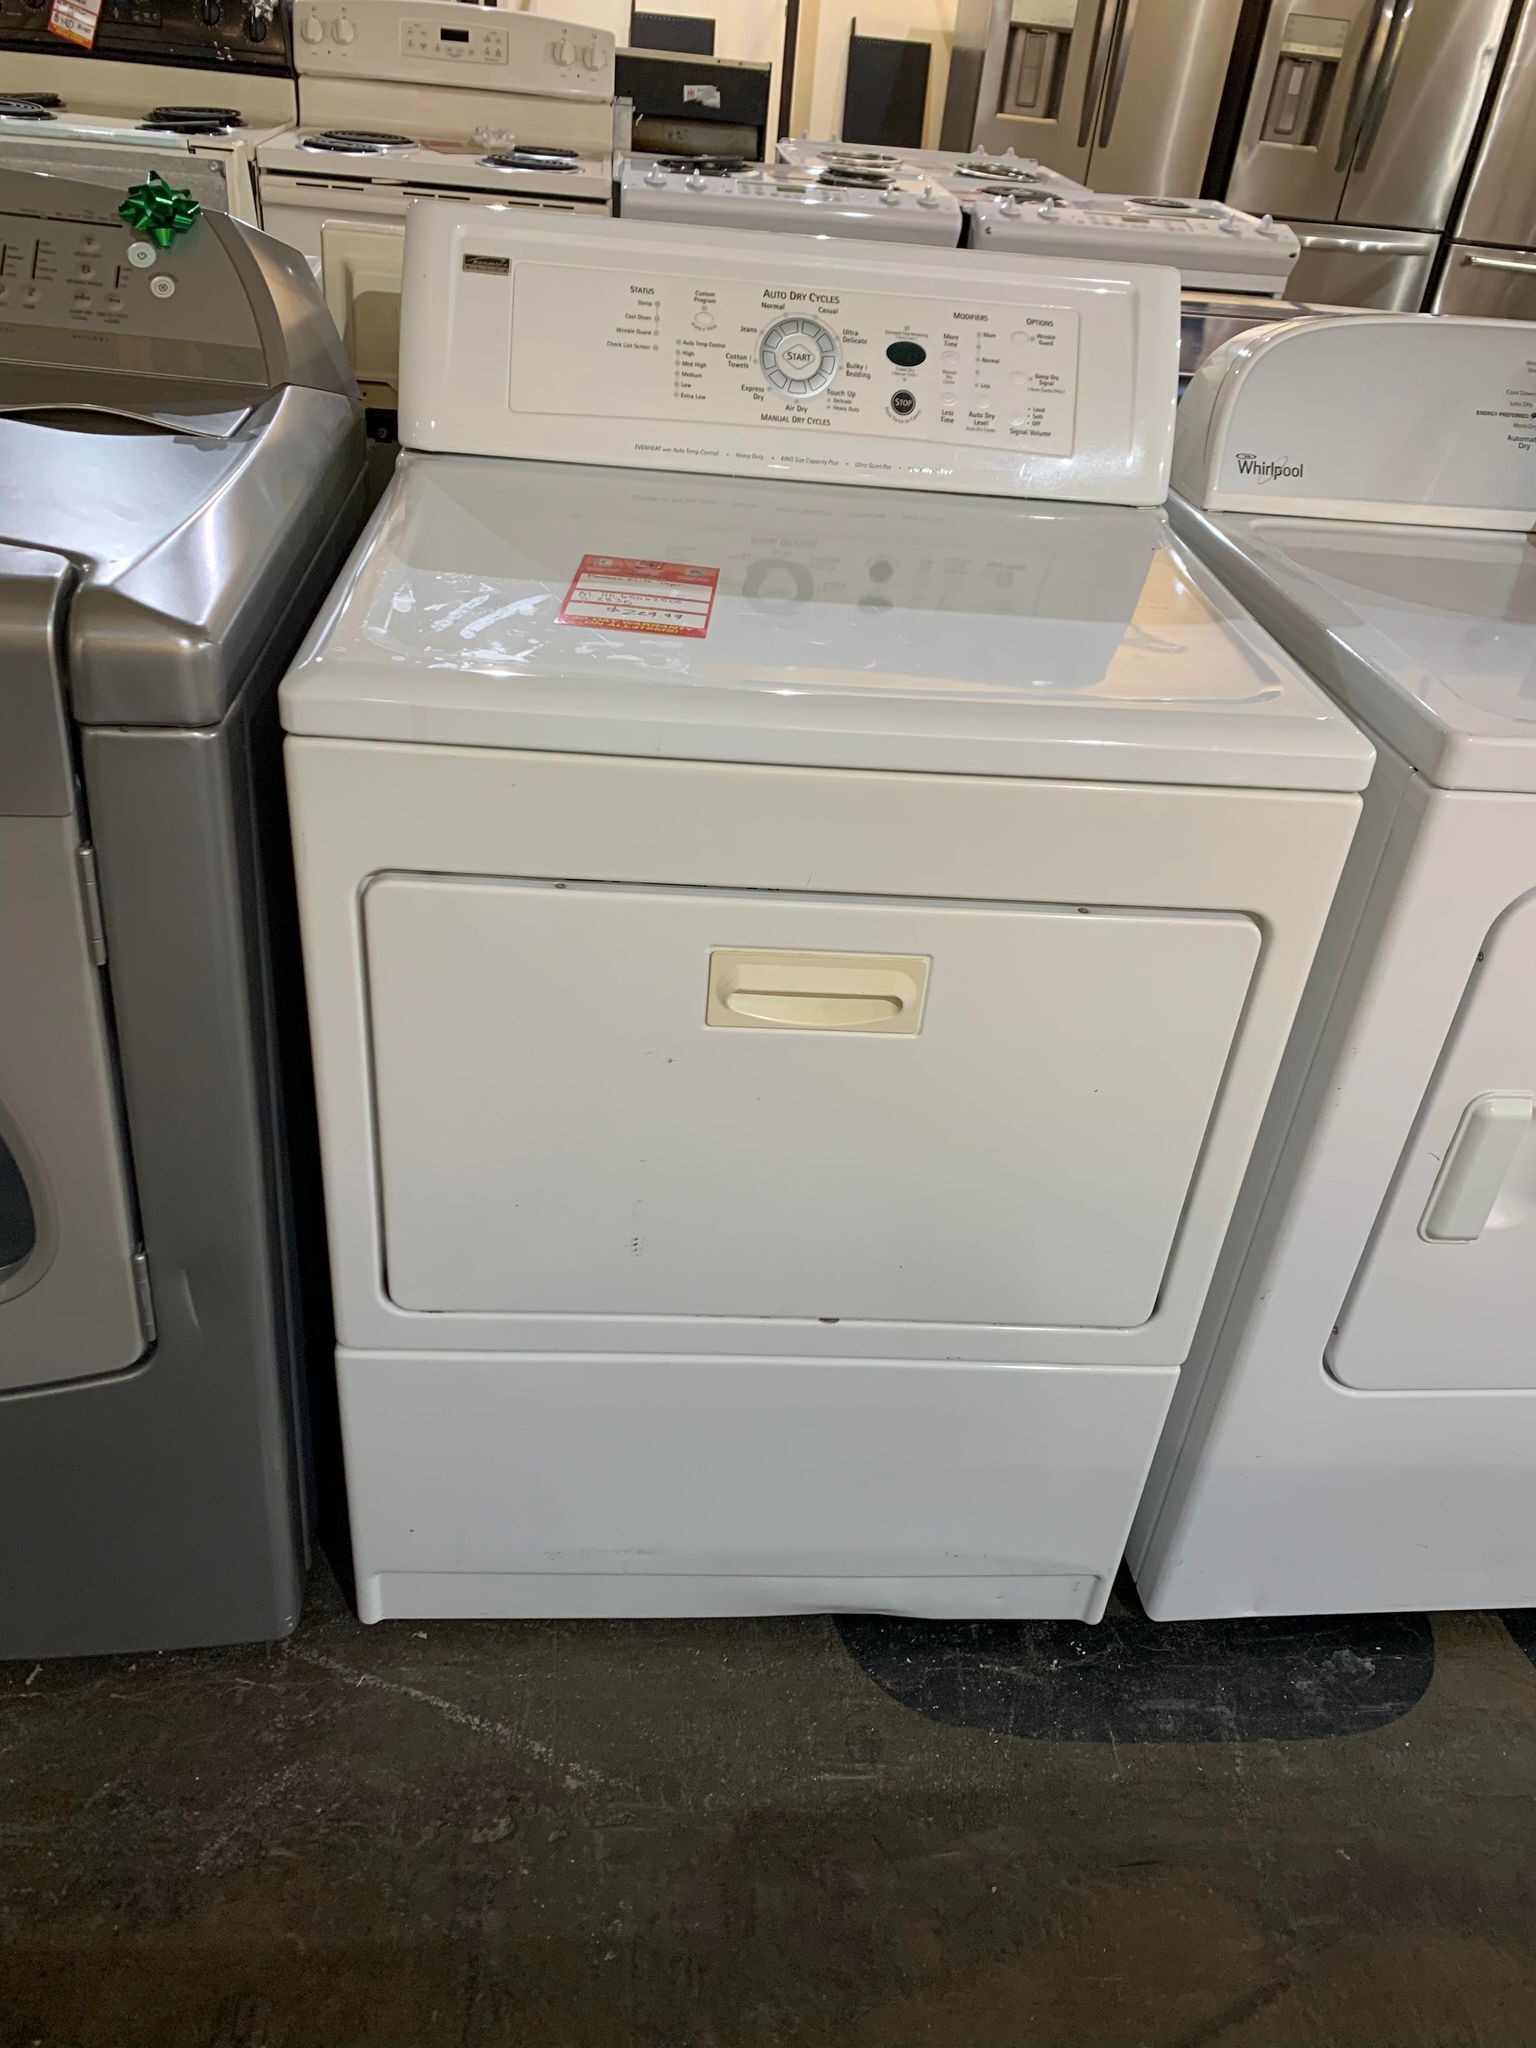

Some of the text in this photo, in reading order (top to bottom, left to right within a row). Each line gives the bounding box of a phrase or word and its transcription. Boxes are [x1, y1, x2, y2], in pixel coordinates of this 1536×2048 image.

[630, 285, 654, 295] STATUS
[694, 296, 716, 304] Program
[763, 289, 840, 304] AUTO DRY CYCLES
[761, 302, 785, 310] Normal
[818, 306, 838, 314] Casual
[953, 312, 988, 321] MODIFIERS
[1026, 318, 1054, 327] OPTIONS
[842, 336, 868, 344] Delicate
[709, 341, 726, 349] Control
[725, 353, 748, 361] Cotton
[787, 352, 810, 361] START
[728, 361, 749, 369] Towels
[846, 362, 864, 371] Bulky
[846, 370, 871, 380] Bedding
[741, 384, 765, 393] Express
[827, 388, 845, 396] Touch
[753, 393, 764, 401] Dry
[895, 398, 913, 406] STOP
[796, 405, 808, 413] Dry
[760, 413, 831, 426] MANUAL DRY CYCLES
[985, 412, 995, 420] Dry
[1518, 442, 1530, 450] Dry
[686, 448, 699, 456] Temp
[806, 458, 827, 466] Capacity
[1238, 460, 1304, 480] Whirlpool
